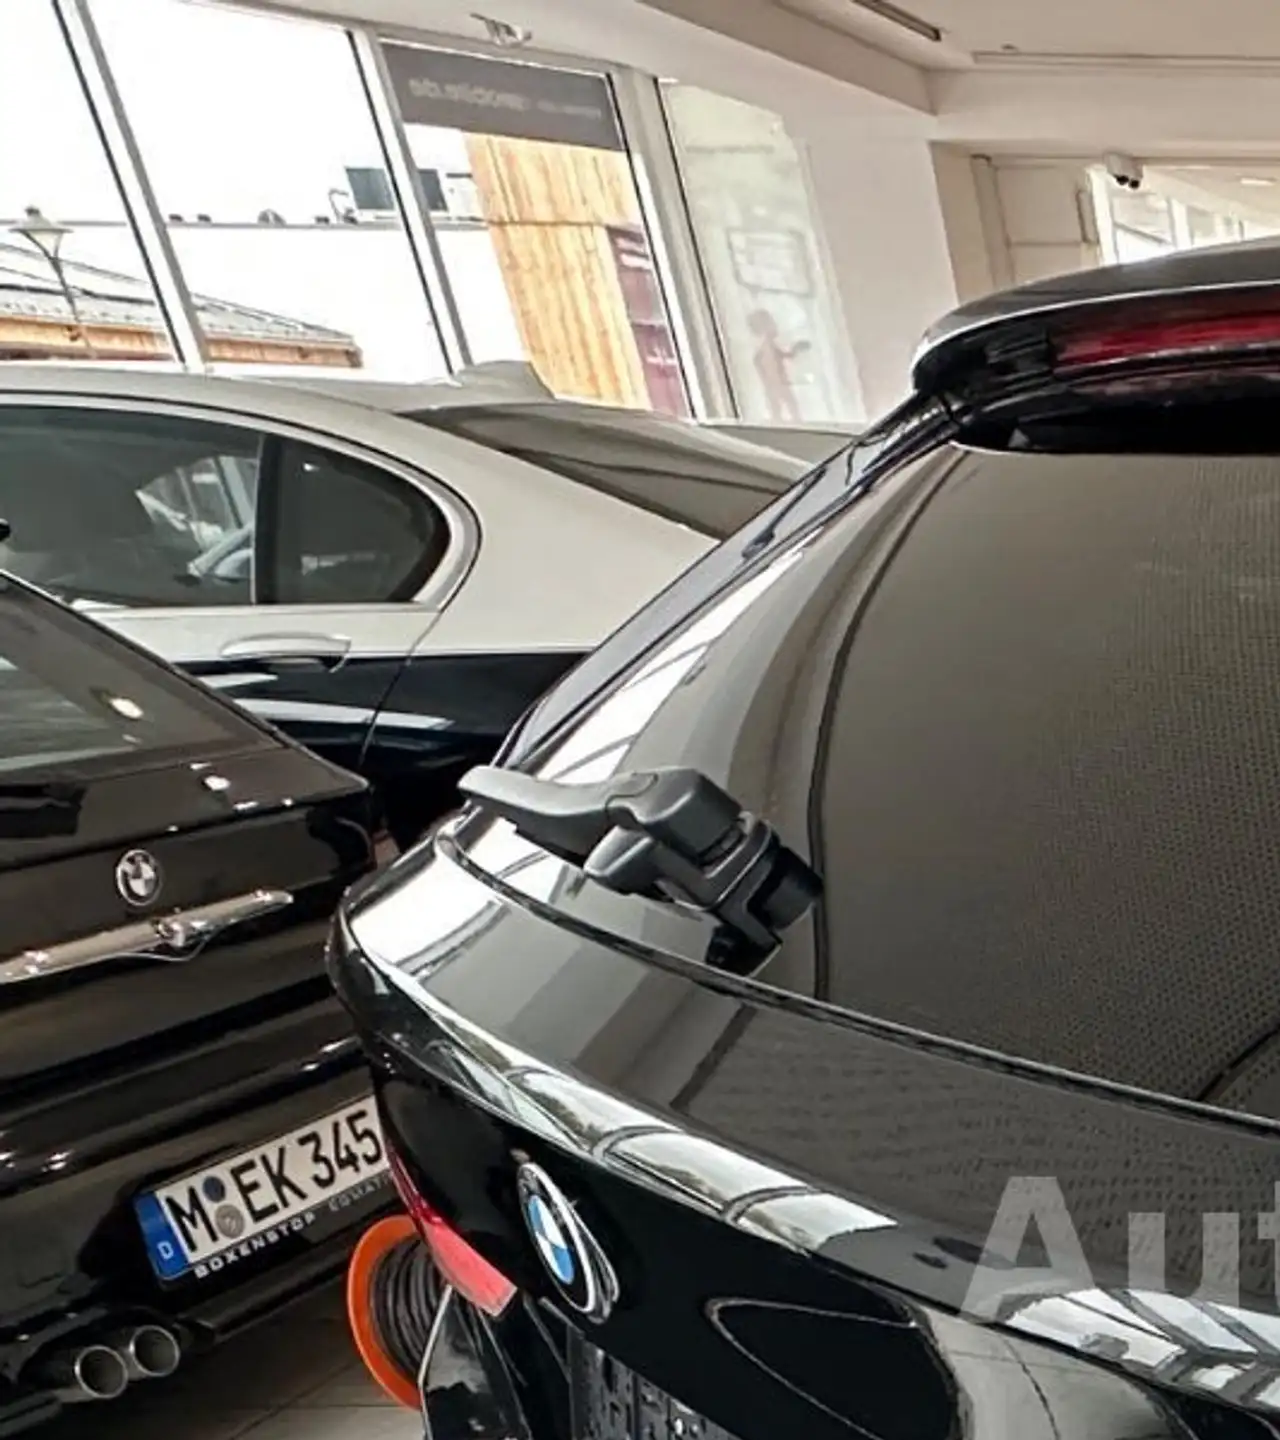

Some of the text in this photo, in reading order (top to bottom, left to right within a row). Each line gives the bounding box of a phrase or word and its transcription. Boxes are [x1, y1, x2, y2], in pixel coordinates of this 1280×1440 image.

[165, 1109, 382, 1253] M EK 345
[157, 1241, 175, 1260] D
[193, 1210, 317, 1279] BOXENSTOP
